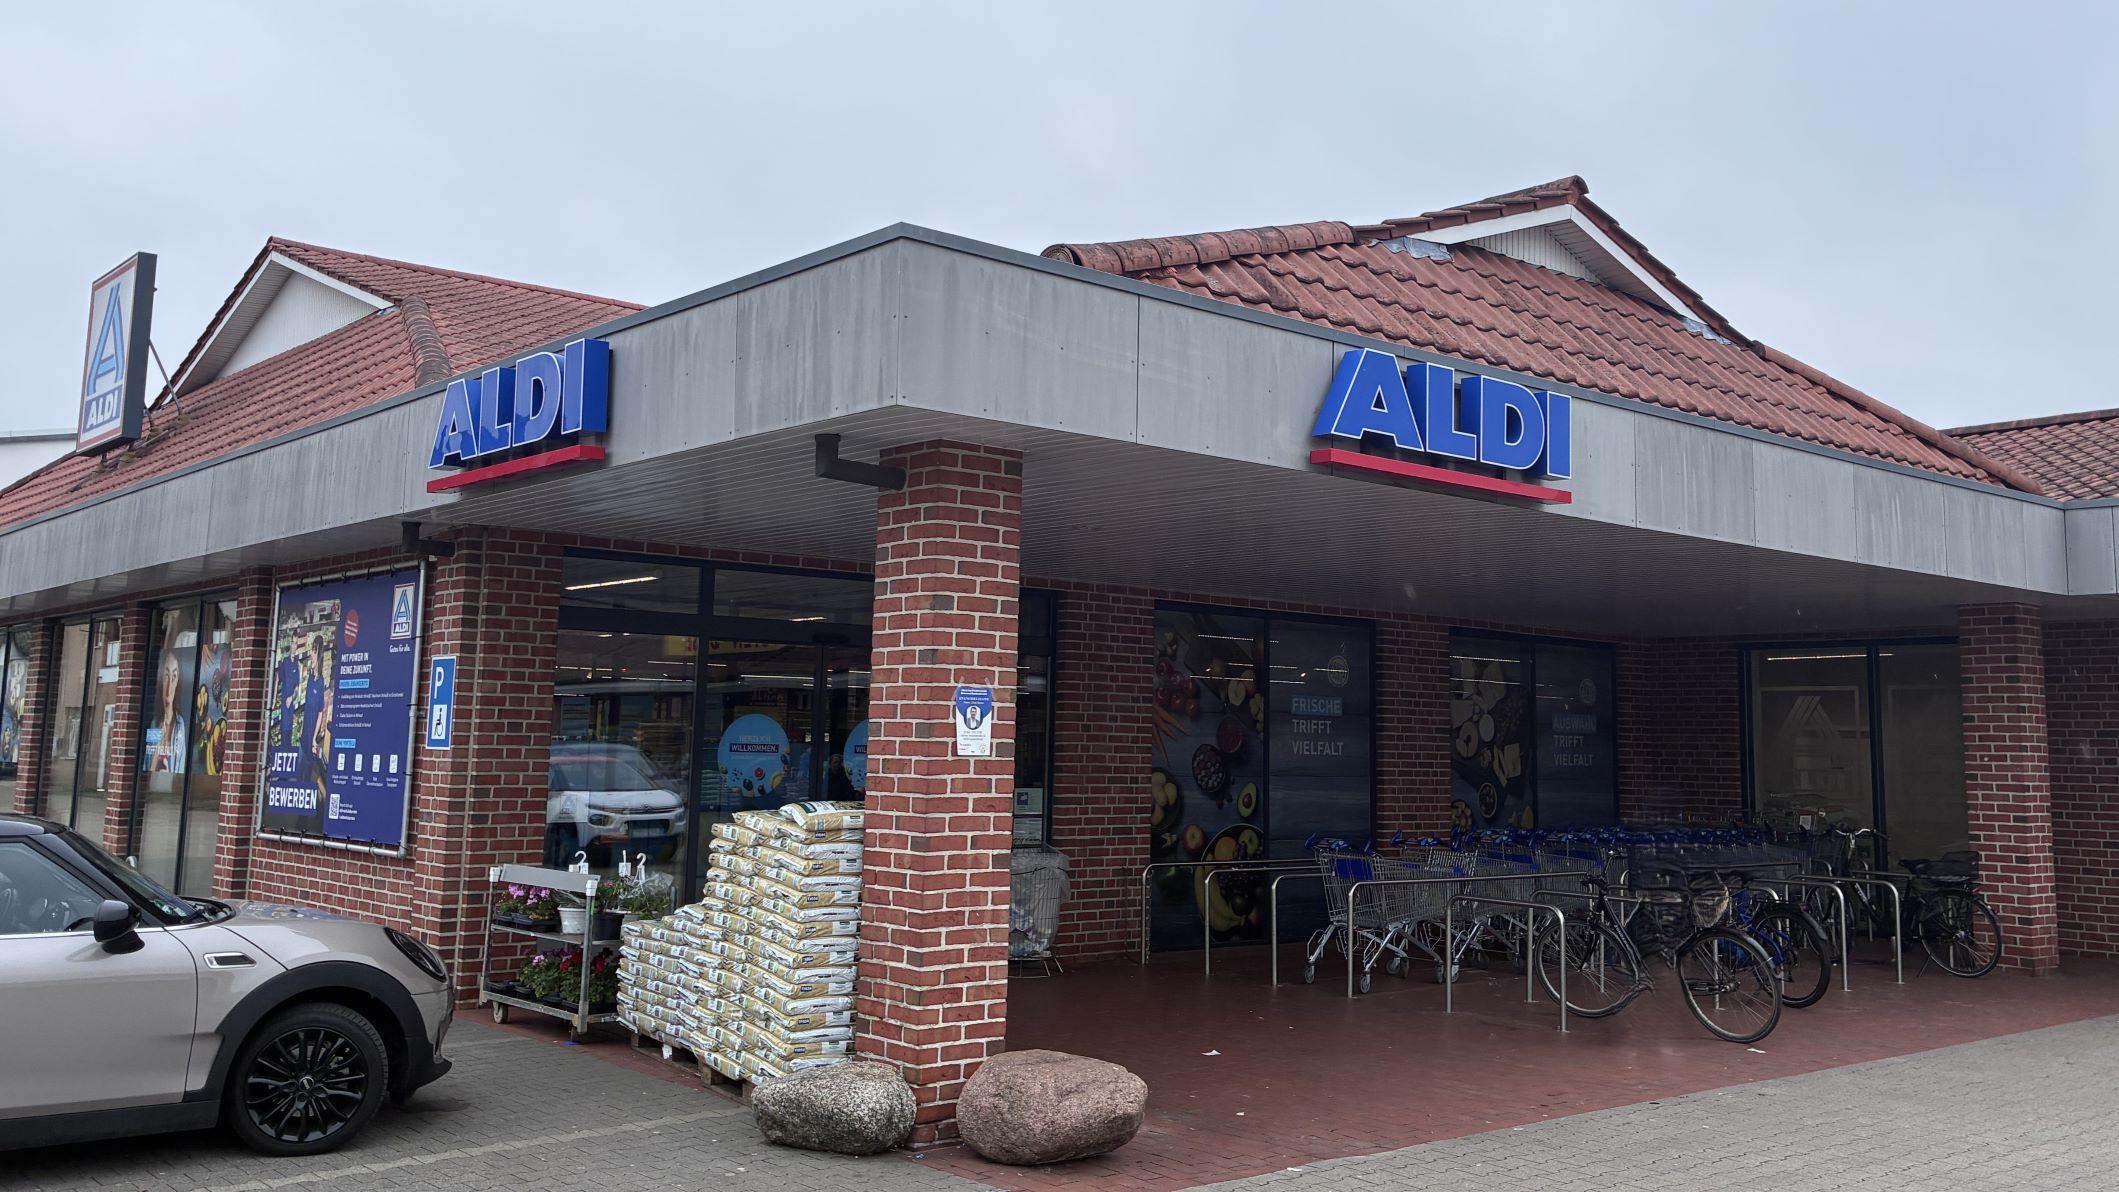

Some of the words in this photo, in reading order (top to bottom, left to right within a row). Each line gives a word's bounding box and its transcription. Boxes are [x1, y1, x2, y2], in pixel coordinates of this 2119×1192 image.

[86, 389, 119, 430] ALDI
[428, 338, 590, 469] ALDI
[1326, 347, 1572, 479] ALDI
[395, 623, 409, 633] ALDI
[341, 653, 350, 663] MIT
[350, 653, 364, 662] POWER
[340, 665, 353, 675] DEINE
[434, 666, 445, 700] P
[1292, 698, 1341, 713] FRISCHE
[1292, 719, 1332, 734] TRIFFT
[1552, 716, 1596, 730] AUSWAHL
[731, 744, 778, 752] WILLKOMMEN.
[1292, 741, 1344, 756] VIELFALT
[1552, 735, 1584, 748] TRIFFT
[271, 752, 298, 772] JETZT
[1553, 753, 1594, 767] VIELFALT
[268, 787, 318, 810] BEWERBEN
